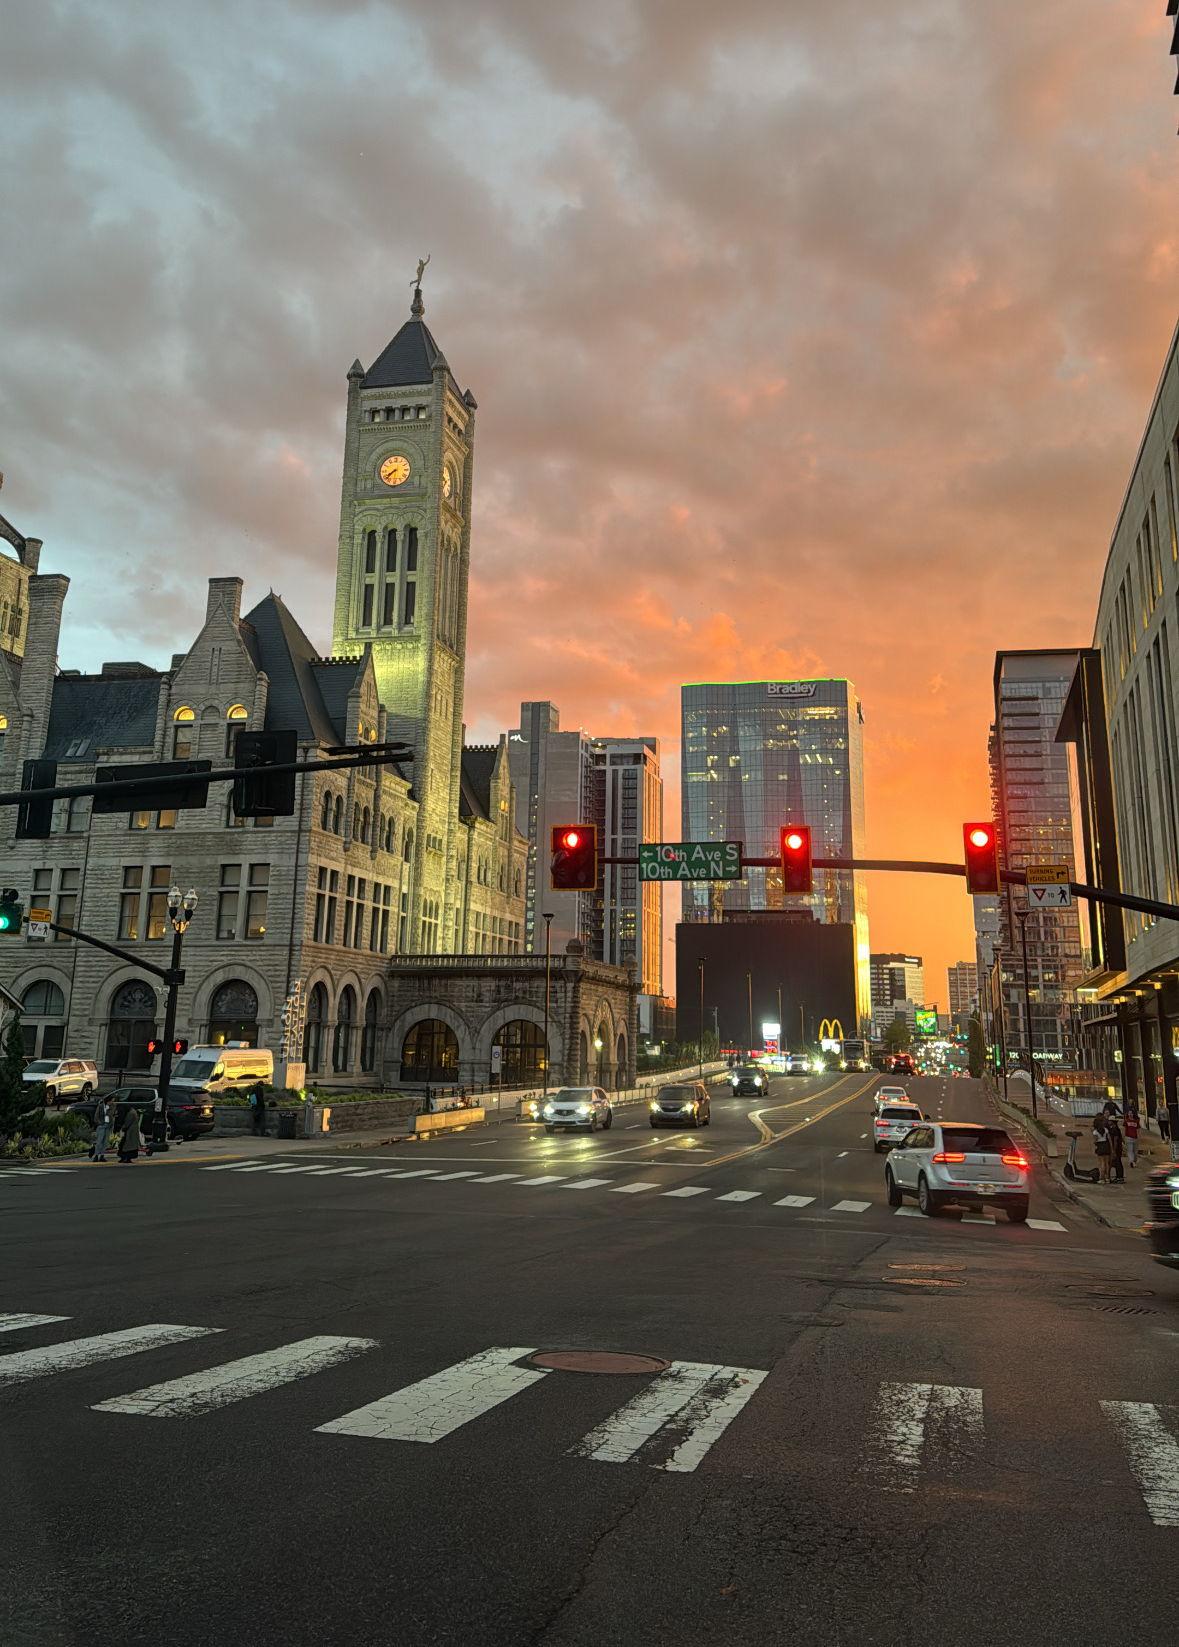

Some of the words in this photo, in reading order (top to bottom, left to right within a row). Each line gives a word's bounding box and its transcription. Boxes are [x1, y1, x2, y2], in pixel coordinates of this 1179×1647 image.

[767, 682, 816, 697] Bradley
[641, 862, 672, 878] 10th
[677, 862, 706, 878] Ave
[710, 861, 723, 877] N
[656, 846, 687, 861] 10th
[691, 845, 721, 861] Ave
[725, 843, 738, 860] S
[283, 996, 292, 1058] UNION
[289, 980, 301, 1058] STATION
[297, 992, 307, 1058] HOTEL
